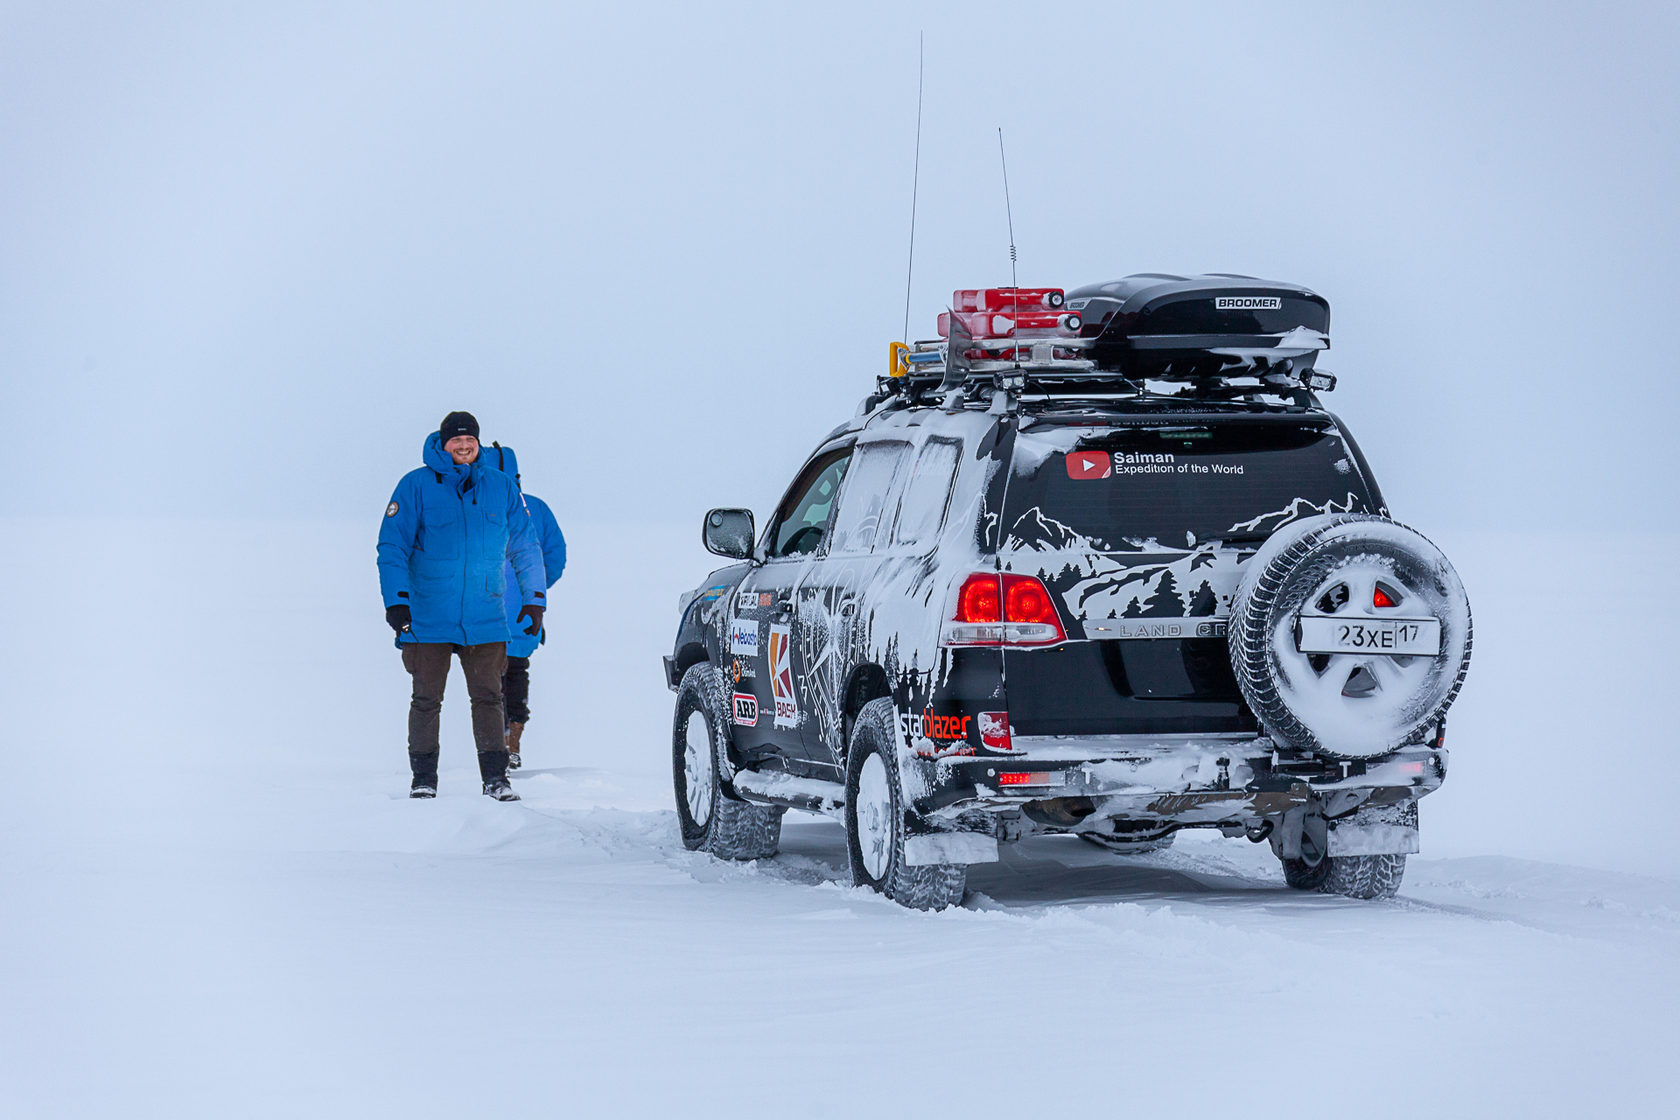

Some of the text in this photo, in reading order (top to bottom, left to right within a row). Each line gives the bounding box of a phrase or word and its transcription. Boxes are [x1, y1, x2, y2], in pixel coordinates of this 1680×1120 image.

[1218, 298, 1277, 308] BROOMER
[1113, 452, 1175, 464] Saiman
[1115, 463, 1244, 476] Expedition of the World
[1120, 624, 1182, 637] LAND
[1399, 625, 1419, 642] 17
[734, 699, 757, 720] ARB
[900, 707, 971, 739] starblazer
